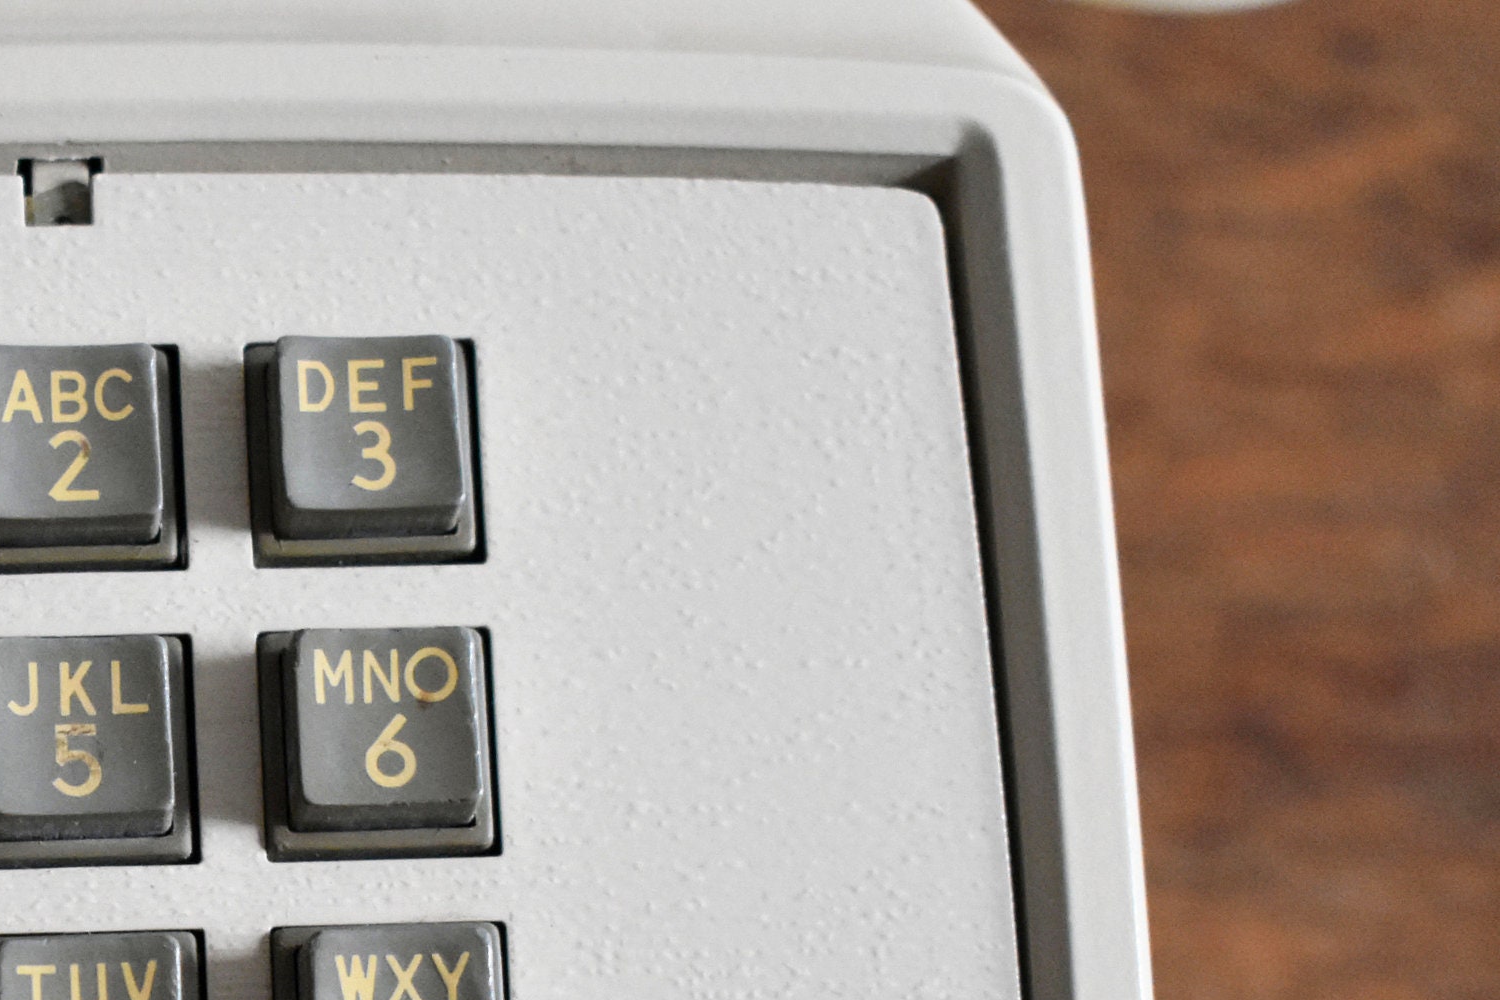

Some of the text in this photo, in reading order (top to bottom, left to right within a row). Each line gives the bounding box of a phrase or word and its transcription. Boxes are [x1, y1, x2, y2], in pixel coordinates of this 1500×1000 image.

[3, 368, 133, 423] ABC
[299, 357, 437, 412] DEF
[49, 430, 100, 502] 2
[354, 421, 396, 490] 3
[10, 660, 149, 716] JKL
[316, 647, 458, 703] MNO
[55, 723, 102, 796] 5
[366, 714, 417, 788] 6
